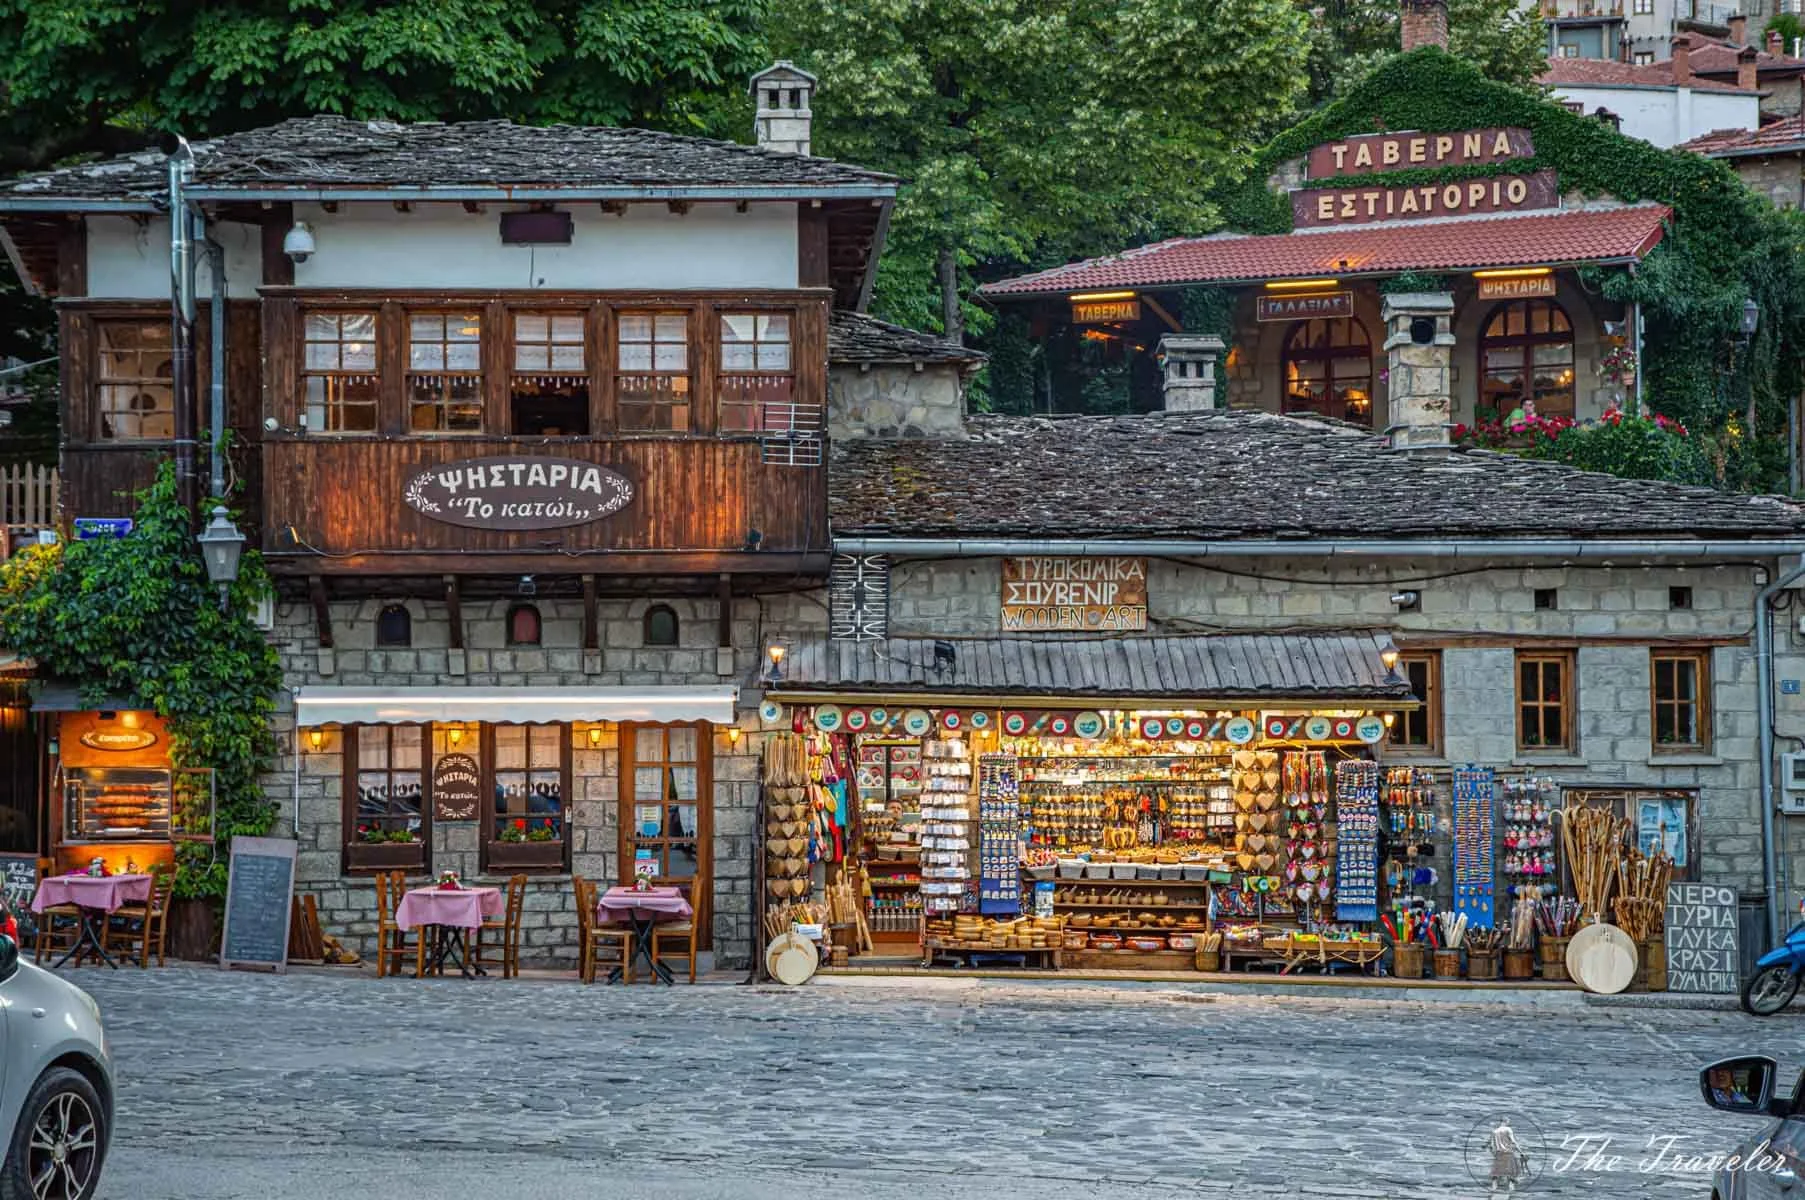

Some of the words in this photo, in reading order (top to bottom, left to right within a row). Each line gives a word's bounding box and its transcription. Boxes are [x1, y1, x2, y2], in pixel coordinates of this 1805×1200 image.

[1331, 131, 1512, 169] ΤΑΒΕΡΝΑ
[1317, 178, 1527, 220] ΕΣΤΙΑΤΟΡΙΟ
[1483, 279, 1552, 295] ΨΗΣΤΑΡΙΑ
[1078, 303, 1134, 321] ΤΑΒΕΡΝΑ
[438, 463, 603, 494] ΨΗΣΤΑΡΙΑ
[1015, 557, 1145, 581] ΤΥΡΟΚΟΜΙΚΑ
[1007, 582, 1119, 605] ΣΟΥΒΕΝΙΡ
[1001, 606, 1085, 629] WOODEN
[1102, 605, 1147, 630] ART
[1667, 885, 1734, 905] ΝΕΡΟ
[1667, 904, 1736, 928] ΤΥΡΙΑ
[1668, 926, 1737, 950] ΓΛΥΚΑ
[1668, 949, 1732, 972] ΚΡΑΣΙ
[1668, 970, 1738, 992] ΖΥΜΑΡΙΚΑ
